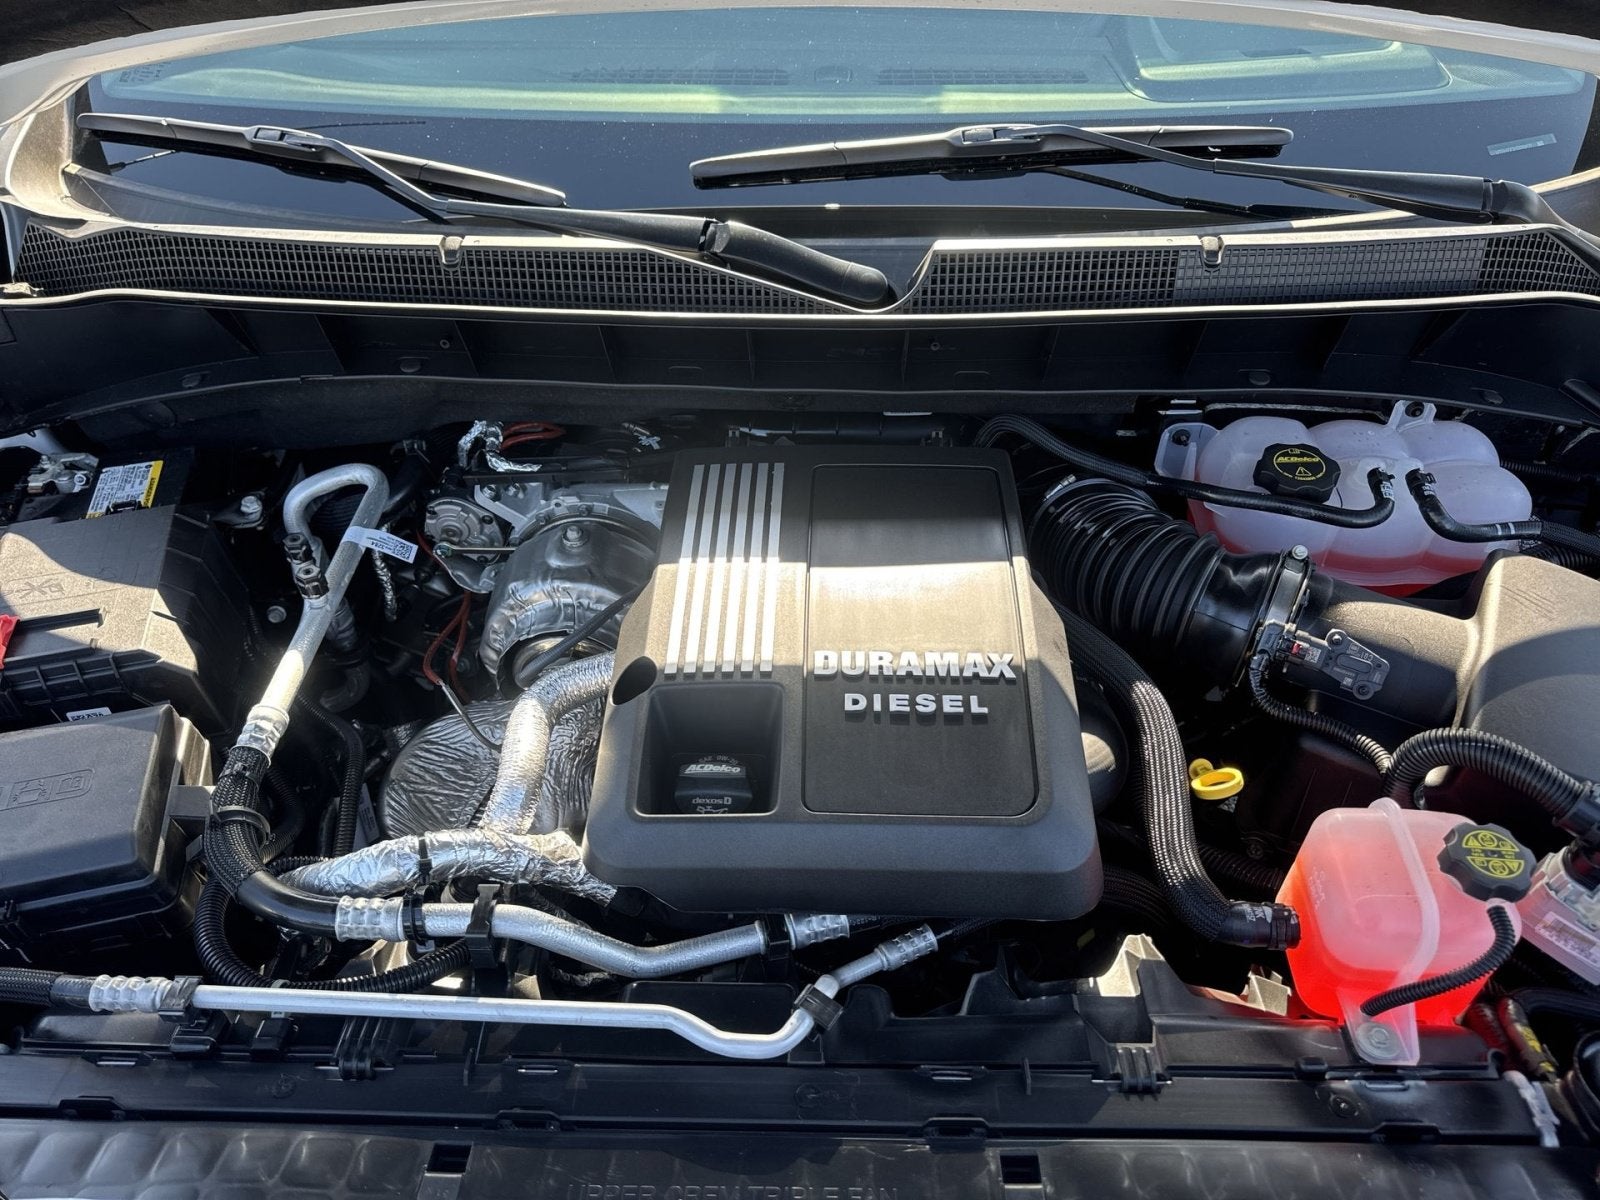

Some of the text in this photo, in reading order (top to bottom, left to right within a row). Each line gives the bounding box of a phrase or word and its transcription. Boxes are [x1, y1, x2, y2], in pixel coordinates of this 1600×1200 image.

[814, 650, 1016, 680] DURAMAX
[844, 693, 988, 714] DIESEL
[684, 764, 741, 774] ACDelco
